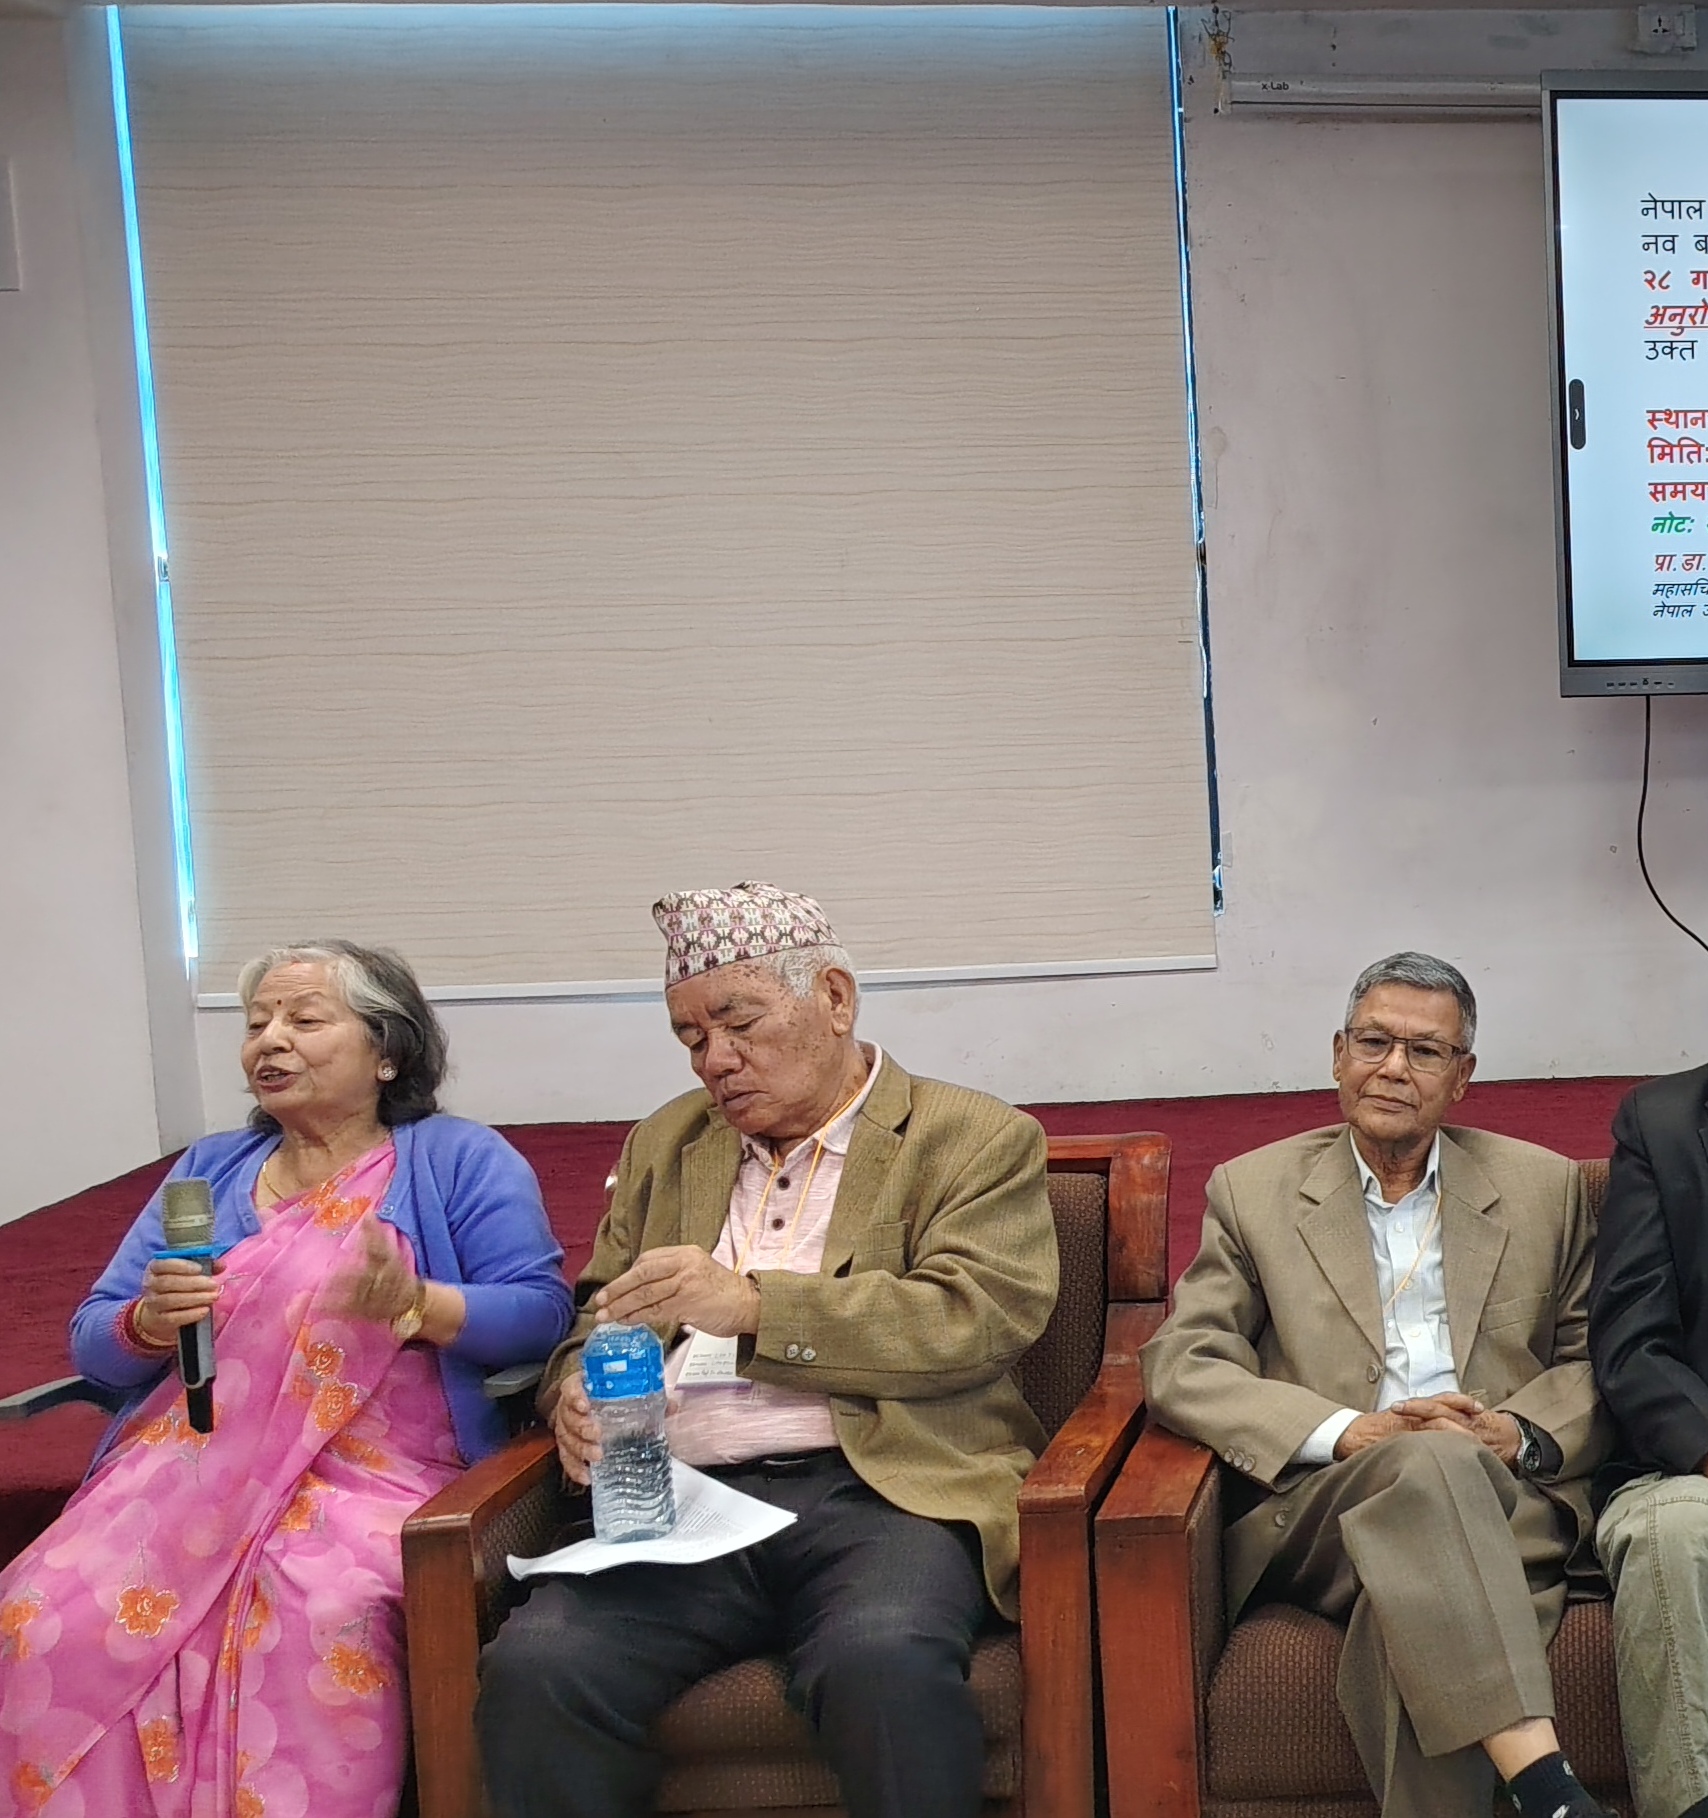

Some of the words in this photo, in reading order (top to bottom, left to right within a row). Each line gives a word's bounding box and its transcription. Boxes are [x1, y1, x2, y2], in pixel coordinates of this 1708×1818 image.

[1261, 81, 1290, 91] x-Lab
[1640, 193, 1706, 220] नेपाल
[1641, 235, 1679, 254] नव
[1643, 270, 1672, 290] २८
[1644, 340, 1698, 361] उक्त
[1651, 512, 1694, 533] नोट:
[1653, 598, 1697, 618] नेपाल
